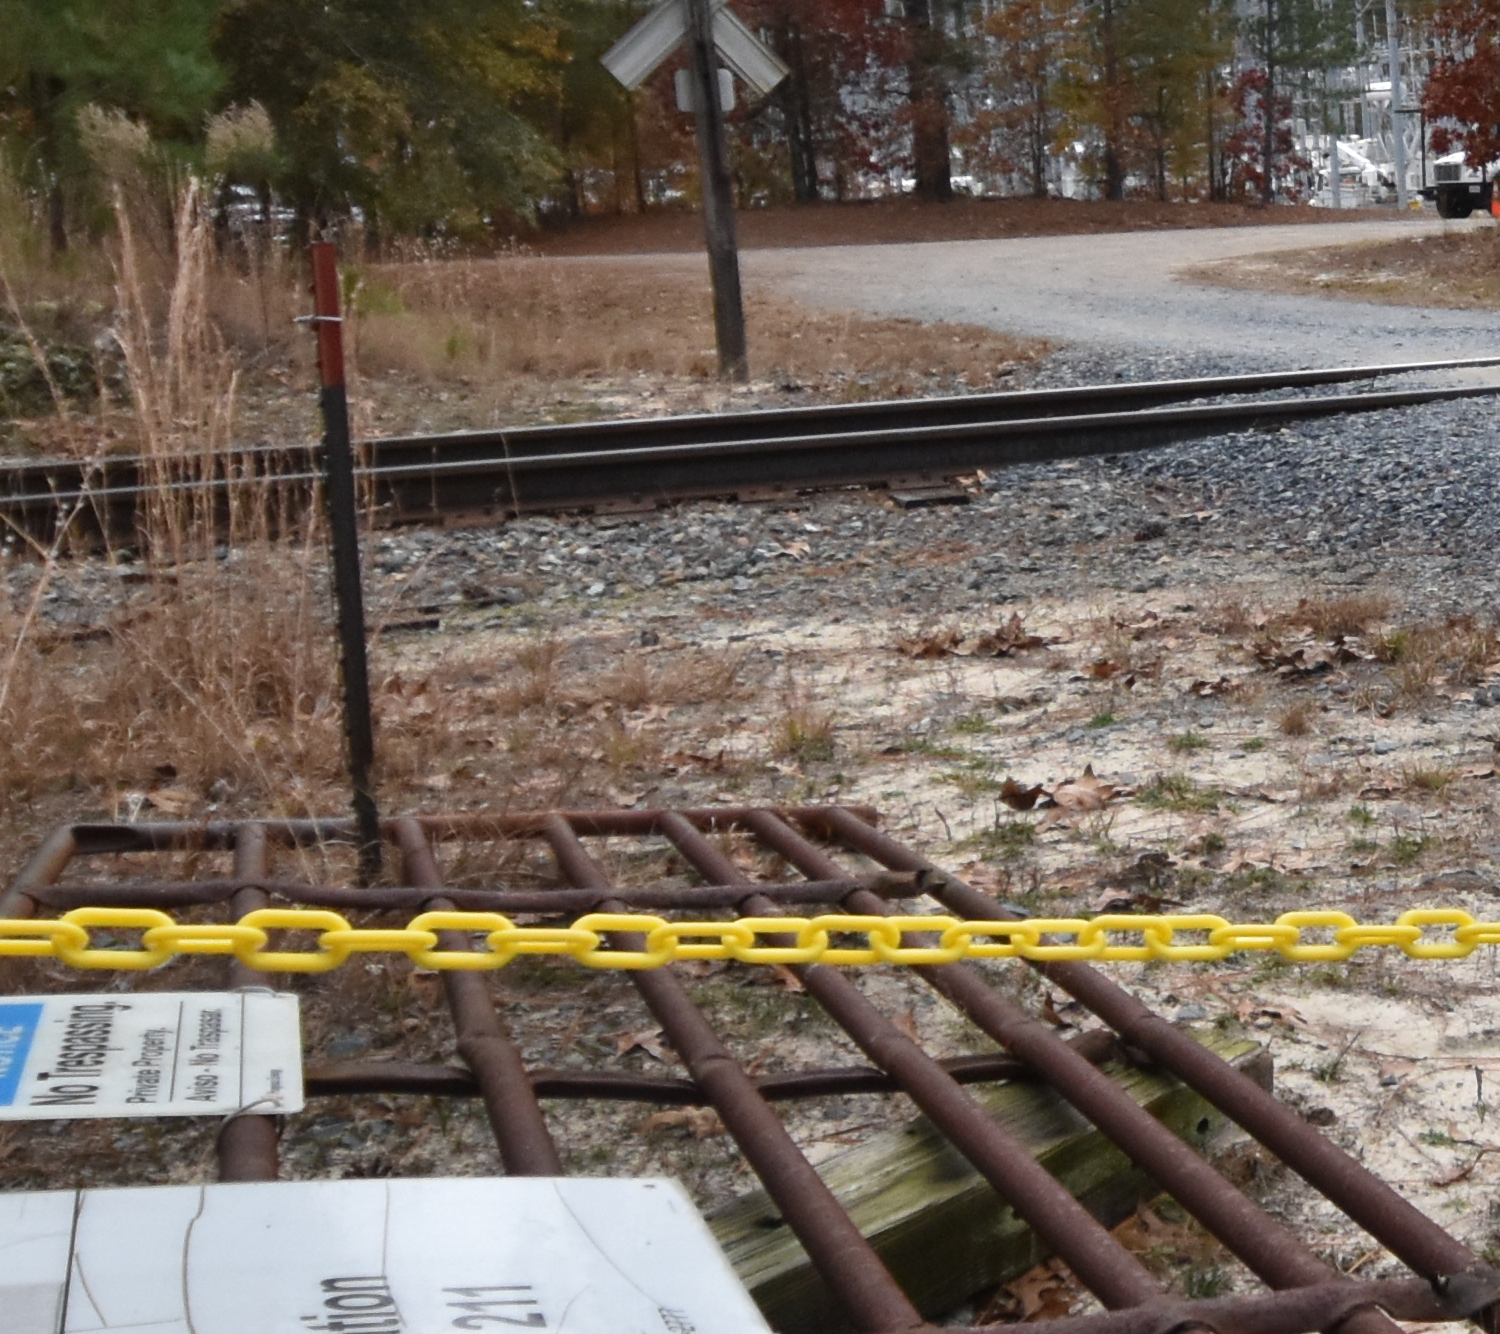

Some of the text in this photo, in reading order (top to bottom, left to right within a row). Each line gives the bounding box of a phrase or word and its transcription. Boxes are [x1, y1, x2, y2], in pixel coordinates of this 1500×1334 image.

[29, 1001, 132, 1106] No Trespassing.
[125, 1027, 173, 1103] Private Property.
[188, 1053, 219, 1066] No
[184, 1074, 219, 1102] Aviso
[441, 1285, 548, 1330] 211
